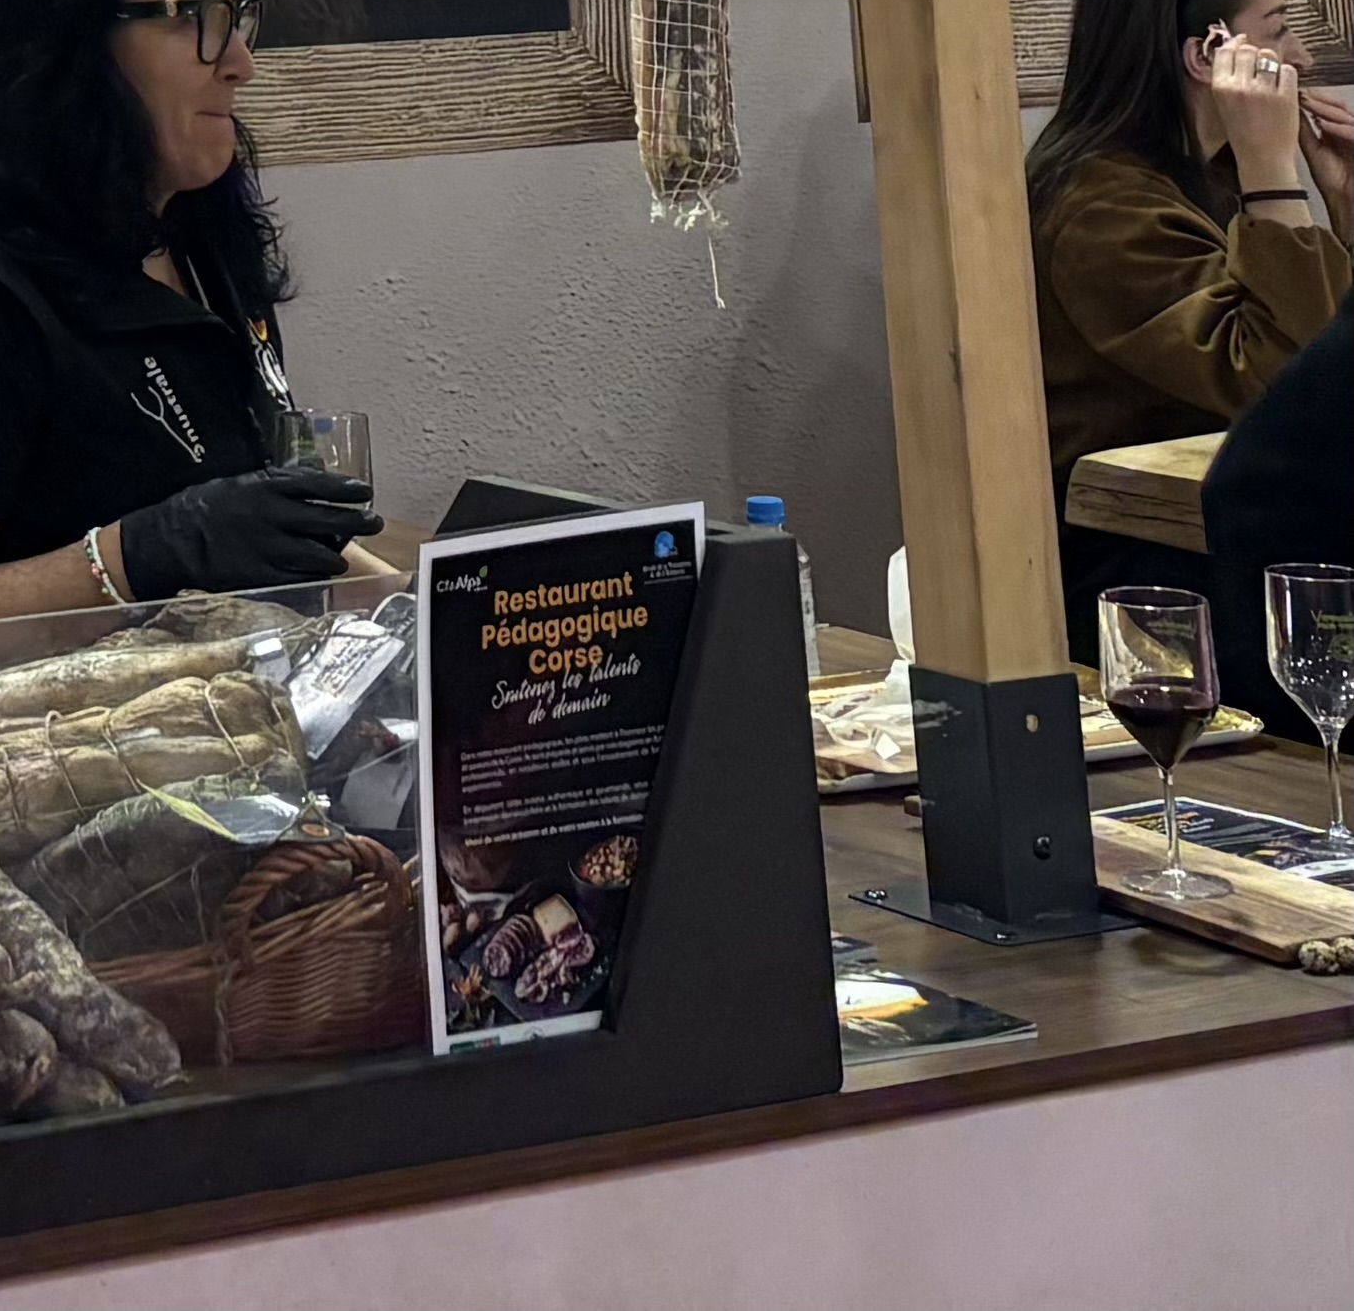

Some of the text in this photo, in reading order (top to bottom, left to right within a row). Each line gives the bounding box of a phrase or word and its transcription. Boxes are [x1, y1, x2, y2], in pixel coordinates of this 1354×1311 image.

[494, 571, 633, 615] Restaurant
[481, 605, 648, 650] Pédagogique
[529, 645, 604, 675] Corse
[552, 688, 611, 719] demain
